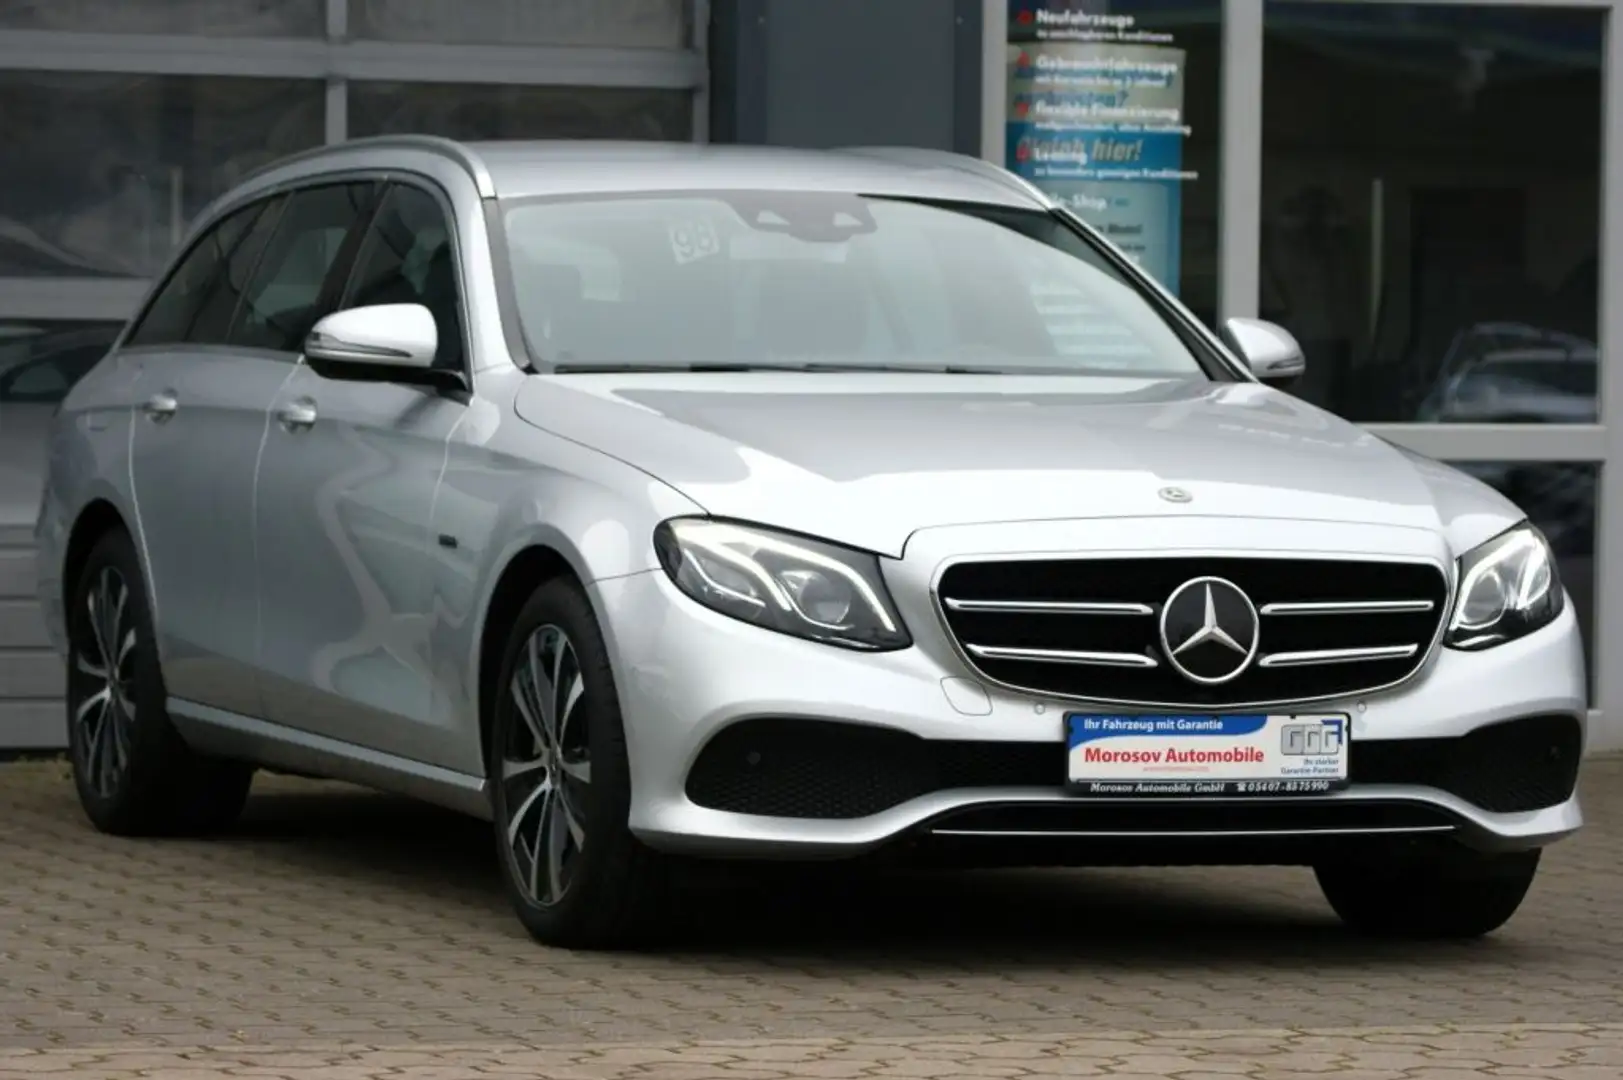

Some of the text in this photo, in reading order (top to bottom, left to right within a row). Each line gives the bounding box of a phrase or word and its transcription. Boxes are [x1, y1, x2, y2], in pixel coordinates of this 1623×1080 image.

[1036, 9, 1135, 28] Neufahrzeuge
[1093, 138, 1144, 161] hier!
[1084, 719, 1224, 732] Ihr Fahrzeug mit Garantie
[1084, 748, 1264, 763] Morosov Automobile
[1090, 783, 1133, 793] Morosov
[1134, 783, 1191, 793] Automobile
[1194, 782, 1225, 793] GmbH
